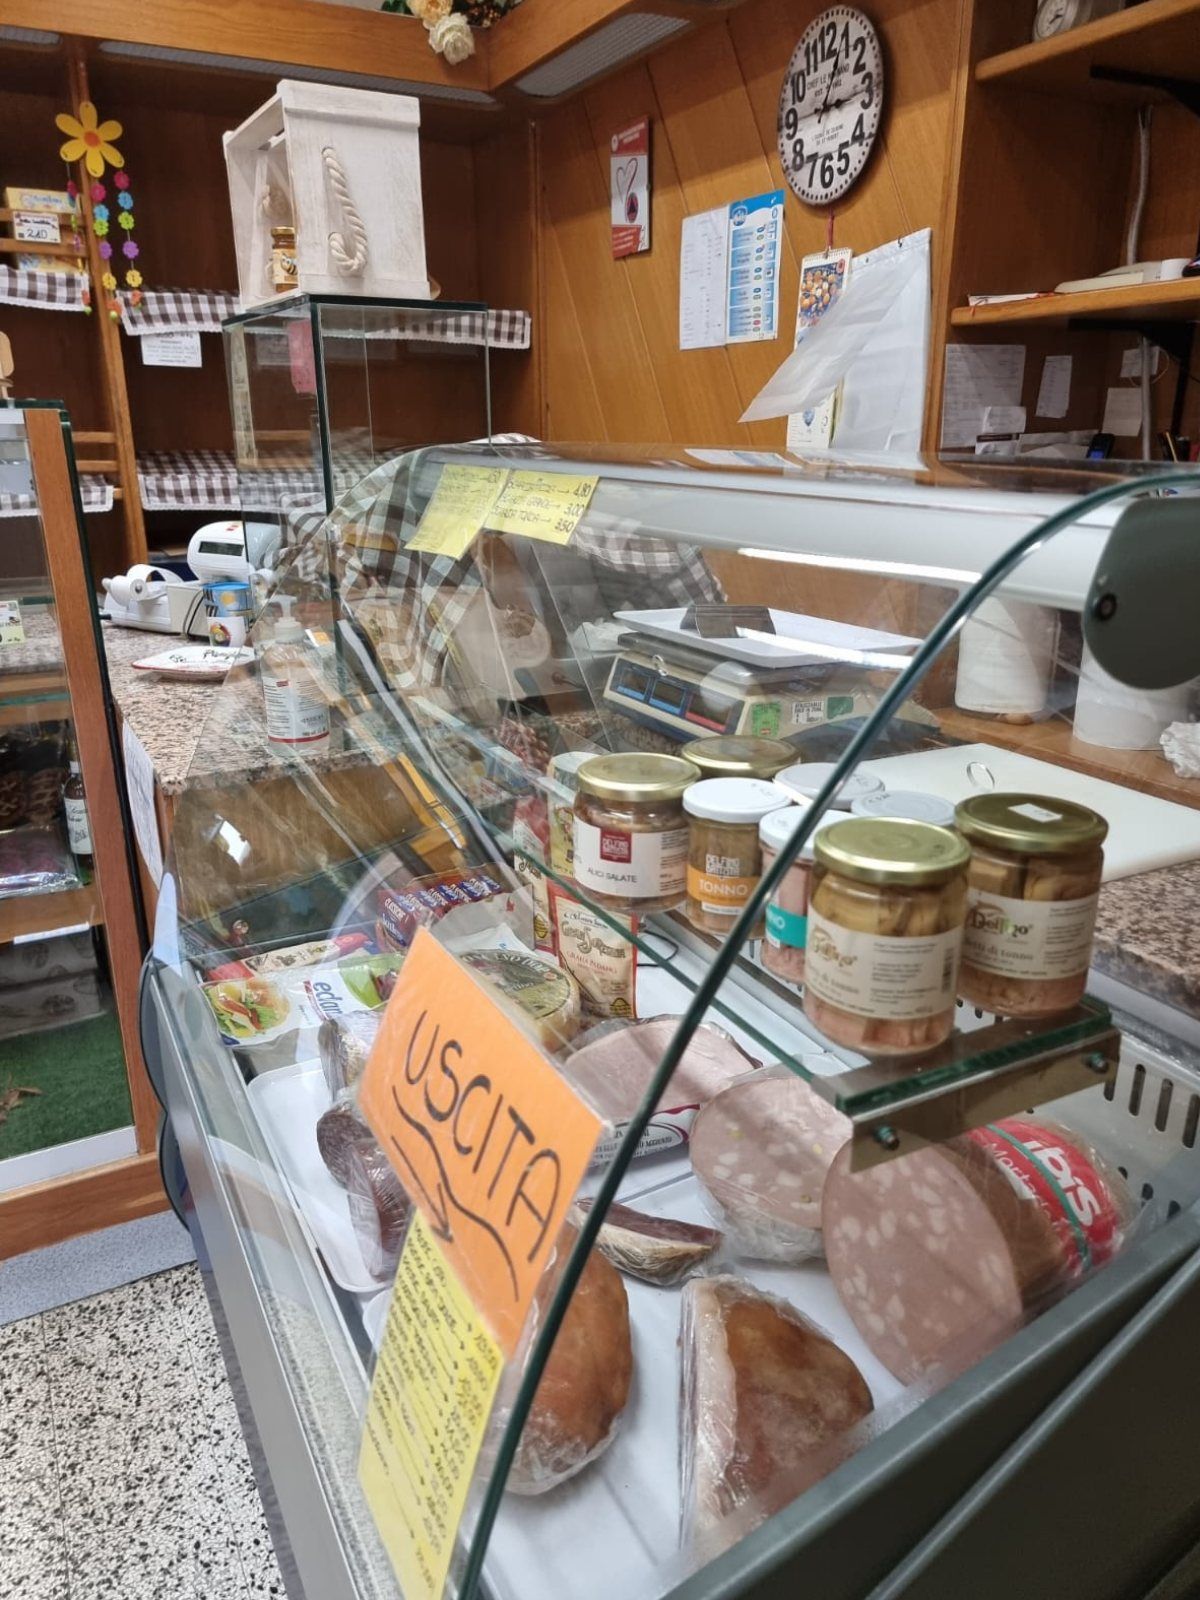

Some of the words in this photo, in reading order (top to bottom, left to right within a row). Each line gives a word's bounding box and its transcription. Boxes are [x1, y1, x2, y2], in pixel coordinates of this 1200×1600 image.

[804, 40, 818, 76] 11
[819, 21, 838, 62] 12
[841, 21, 849, 59] 1
[853, 36, 866, 75] 2
[790, 70, 806, 105] 10
[861, 72, 874, 109] 3
[785, 108, 798, 140] 9
[851, 113, 865, 147] 4
[792, 138, 804, 171] 8
[805, 152, 819, 188] 7
[820, 152, 834, 188] 6
[837, 140, 850, 175] 5
[606, 872, 637, 883] SALATE
[699, 879, 748, 896] TONNO
[404, 1009, 562, 1263] USCITA
